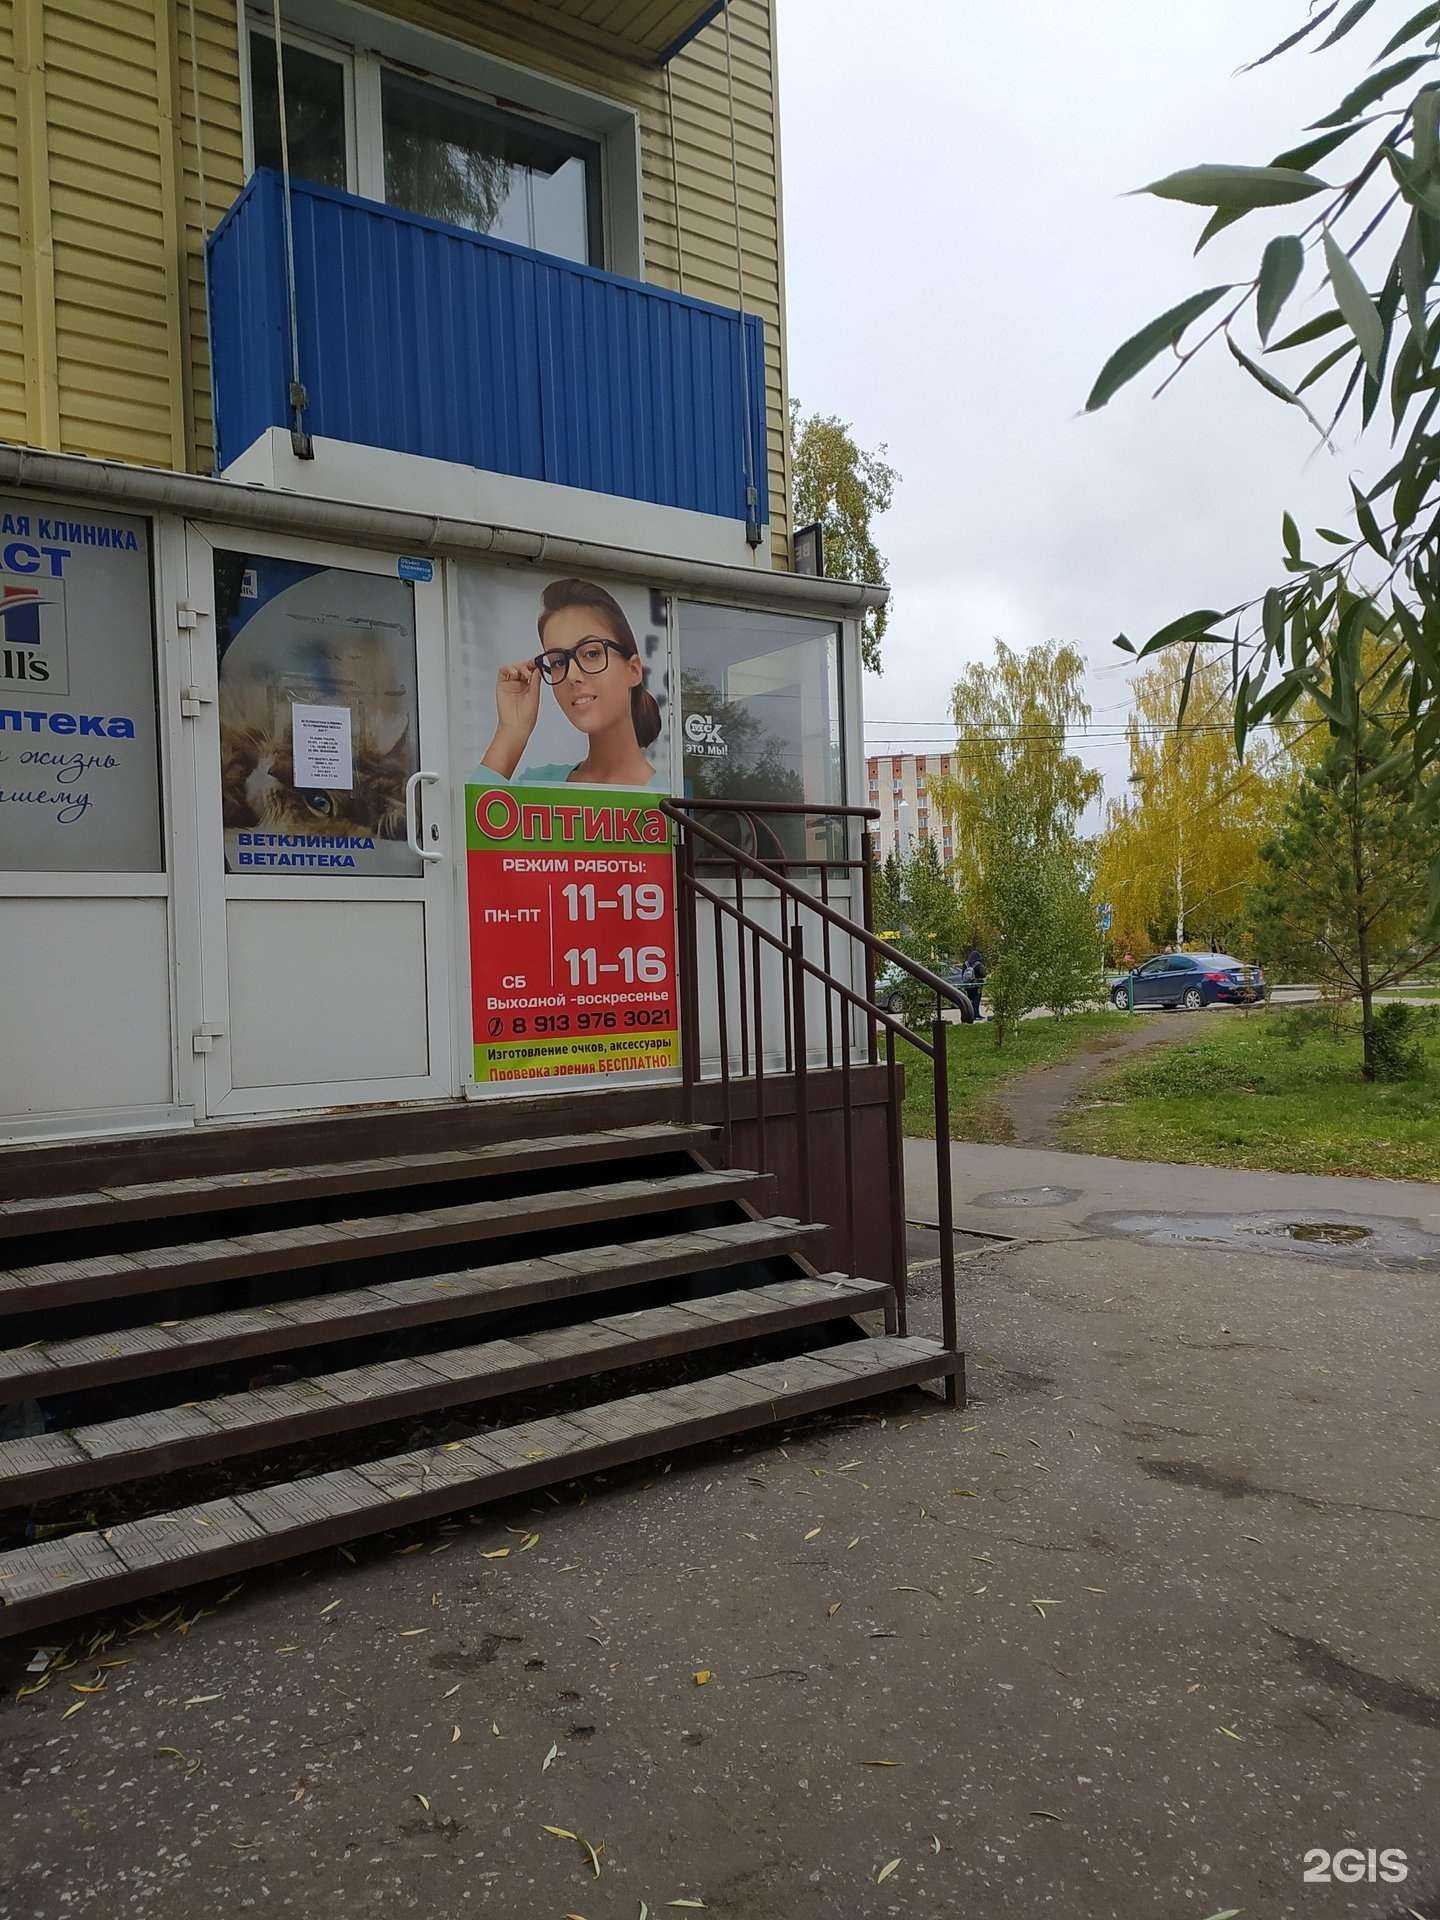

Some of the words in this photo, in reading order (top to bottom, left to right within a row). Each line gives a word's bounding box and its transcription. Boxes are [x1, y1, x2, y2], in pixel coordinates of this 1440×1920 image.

[2, 513, 30, 537] АЯ
[38, 518, 138, 551] КЛИНИКА
[0, 542, 72, 577] СТ
[0, 650, 50, 681] ll's
[20, 751, 121, 784] жизнь
[475, 790, 668, 843] Оптика
[238, 832, 375, 850] ВЕТКЛИНИКА
[239, 852, 355, 868] ВЕТАПТЕКА
[502, 859, 568, 873] РЕЖИМ
[574, 859, 647, 874] РАБОТЫ:
[561, 883, 665, 922] 11-19
[563, 946, 667, 986] 11-16
[502, 975, 527, 989] СБ
[487, 993, 566, 1011] Выходной
[512, 1016, 527, 1034] 8
[534, 1014, 570, 1033] 913
[577, 1011, 617, 1030] 976
[623, 1008, 671, 1027] 3021
[488, 1045, 569, 1061] Изготовление
[571, 1042, 608, 1054] очков,
[610, 1037, 672, 1052] аксессуары
[553, 1061, 596, 1077] зрения
[598, 1054, 672, 1073] БЕСПЛАТНО!
